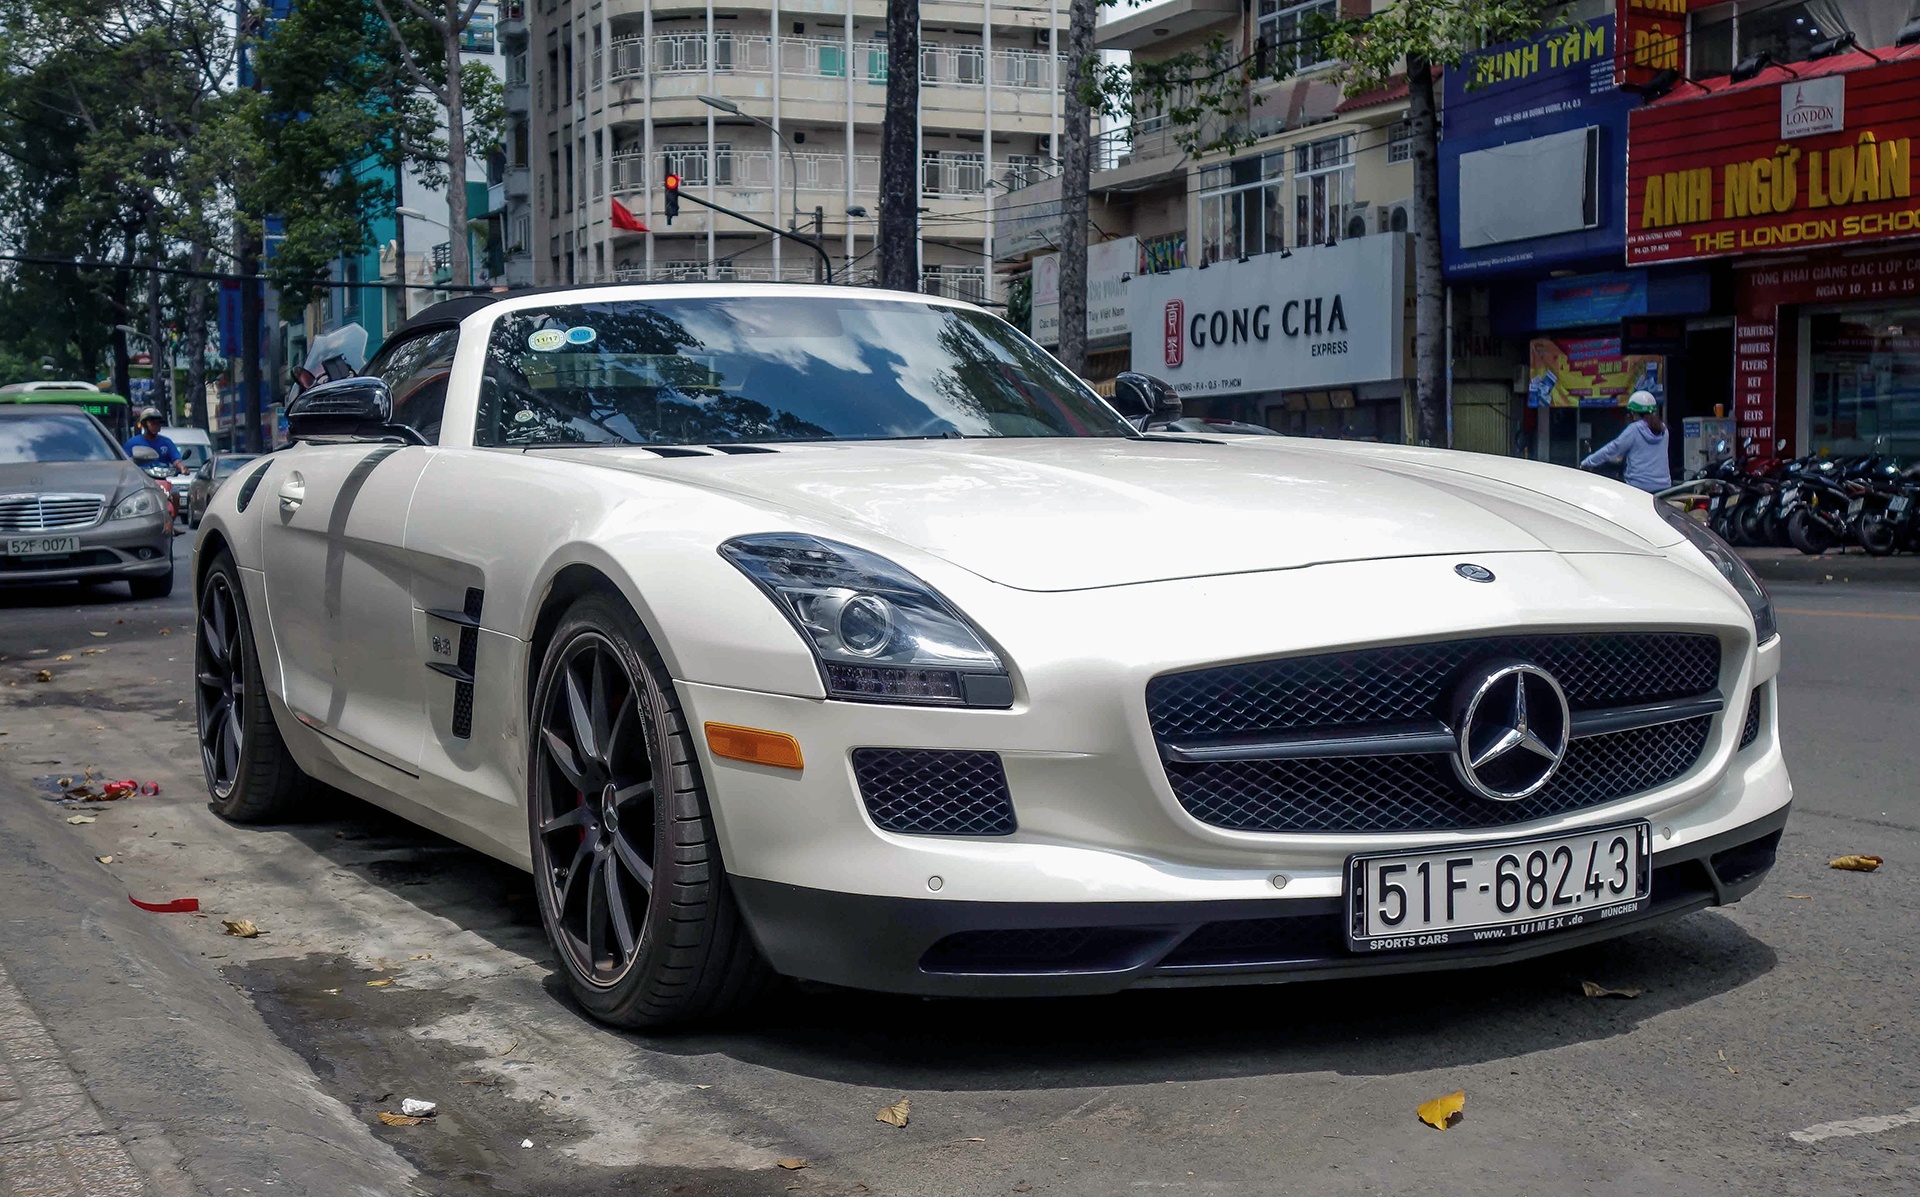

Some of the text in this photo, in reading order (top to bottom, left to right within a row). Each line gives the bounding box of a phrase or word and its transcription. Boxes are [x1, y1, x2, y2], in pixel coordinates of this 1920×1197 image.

[1786, 107, 1834, 125] LONDON
[1642, 167, 1712, 229] ANH
[1808, 131, 1911, 208] LUÂN
[1690, 230, 1735, 253] THE
[1740, 219, 1837, 248] LONDON
[1782, 268, 1809, 283] KHAI
[1871, 281, 1883, 293] 11
[1190, 294, 1348, 348] GONG CHA
[1738, 324, 1774, 338] STARTERS
[1311, 340, 1348, 357] EXPRESS
[1740, 342, 1770, 355] MOVERS
[1741, 359, 1768, 371] FLYERS
[1747, 376, 1761, 388] KET
[1747, 393, 1761, 405] PET
[1744, 410, 1764, 421] IELTS
[1738, 427, 1758, 438] TOEFL
[11, 537, 74, 554] 52F-0071
[1378, 836, 1630, 926] 51F-682.43
[1370, 936, 1416, 950] SPORTS
[1418, 933, 1449, 946] CARS
[1601, 902, 1638, 918] MÜNCHEN
